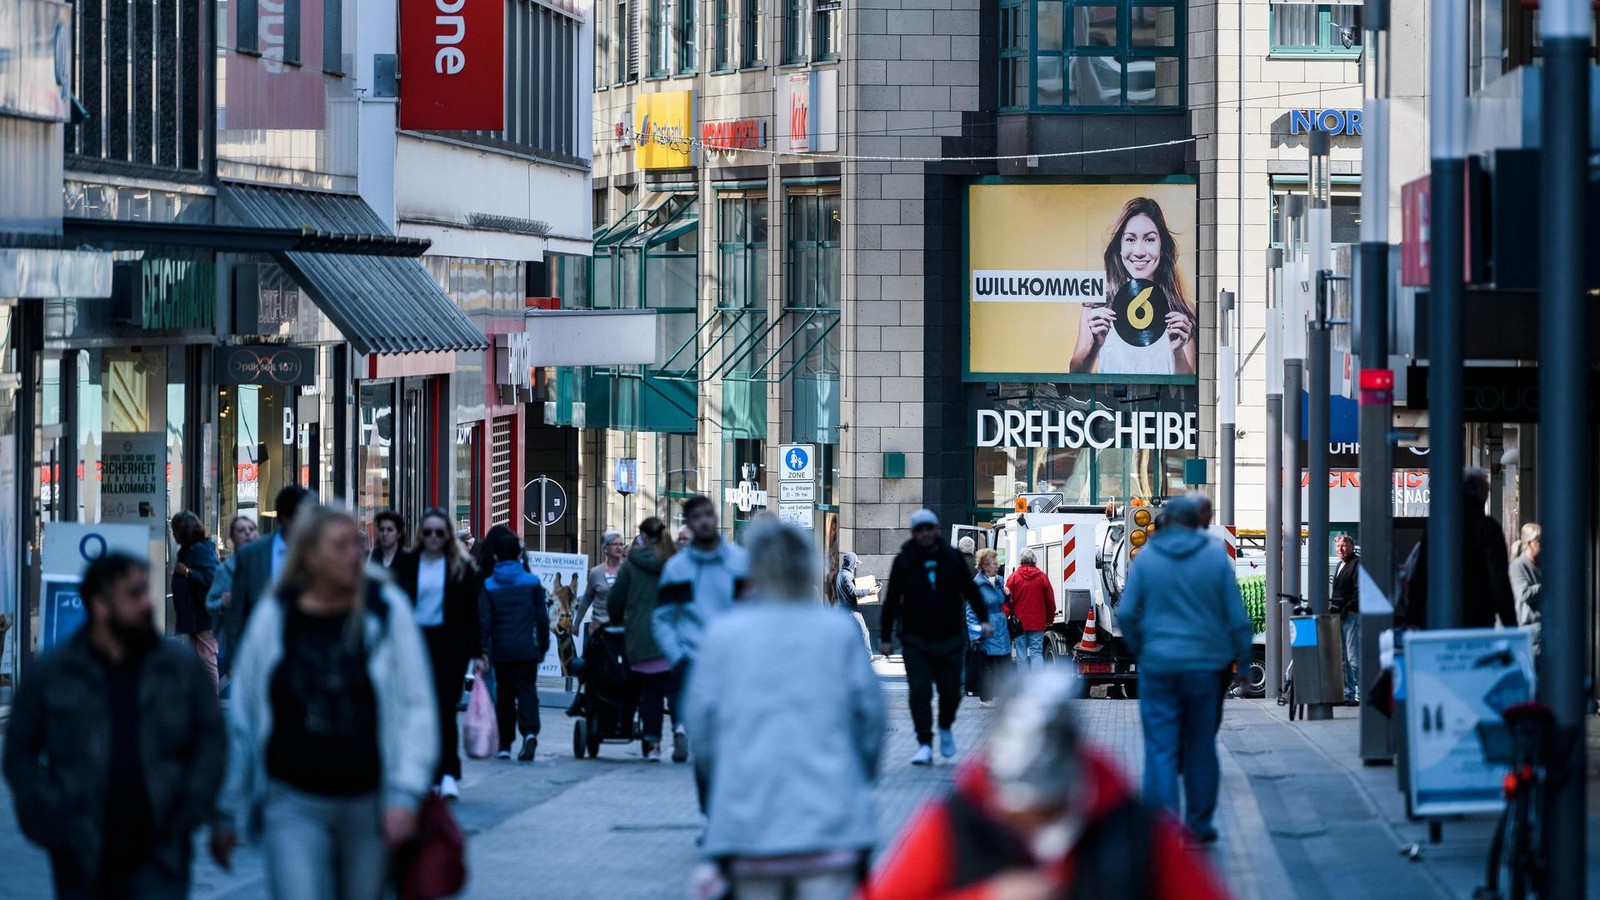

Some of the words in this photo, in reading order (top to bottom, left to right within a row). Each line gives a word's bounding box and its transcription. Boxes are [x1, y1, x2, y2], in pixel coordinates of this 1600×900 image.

[975, 277, 1104, 297] WILLKOMMEN
[1126, 286, 1154, 330] 6
[976, 409, 1196, 450] DREHSCHEIBE
[101, 462, 156, 475] SICHERHEIT
[101, 483, 156, 494] WILLKOMMEN
